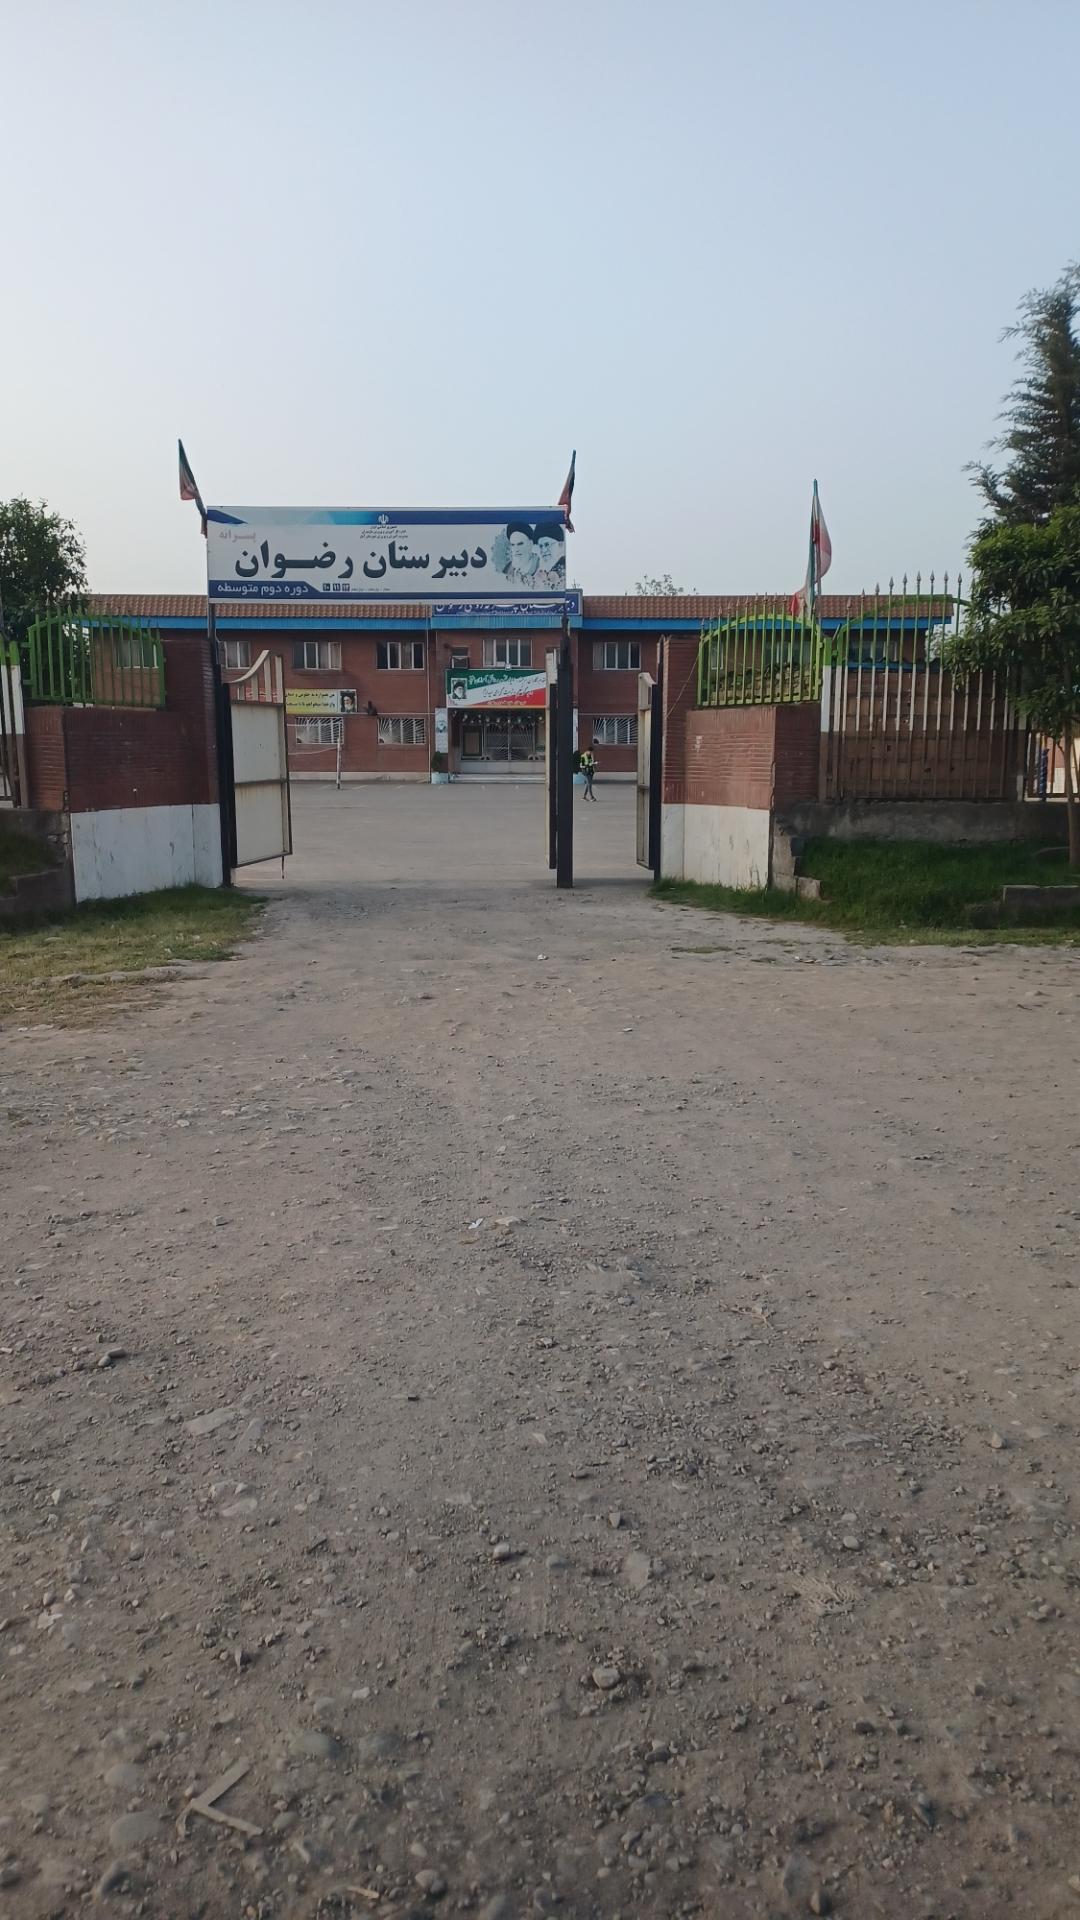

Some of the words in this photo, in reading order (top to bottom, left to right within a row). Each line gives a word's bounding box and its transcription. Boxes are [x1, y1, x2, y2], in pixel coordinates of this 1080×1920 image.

[219, 529, 256, 543] پسرانه
[235, 540, 353, 578] رضوان
[363, 540, 487, 578] دبیرستان
[217, 582, 259, 596] متوسطه
[261, 585, 282, 596] دوم
[284, 585, 309, 596] دوره
